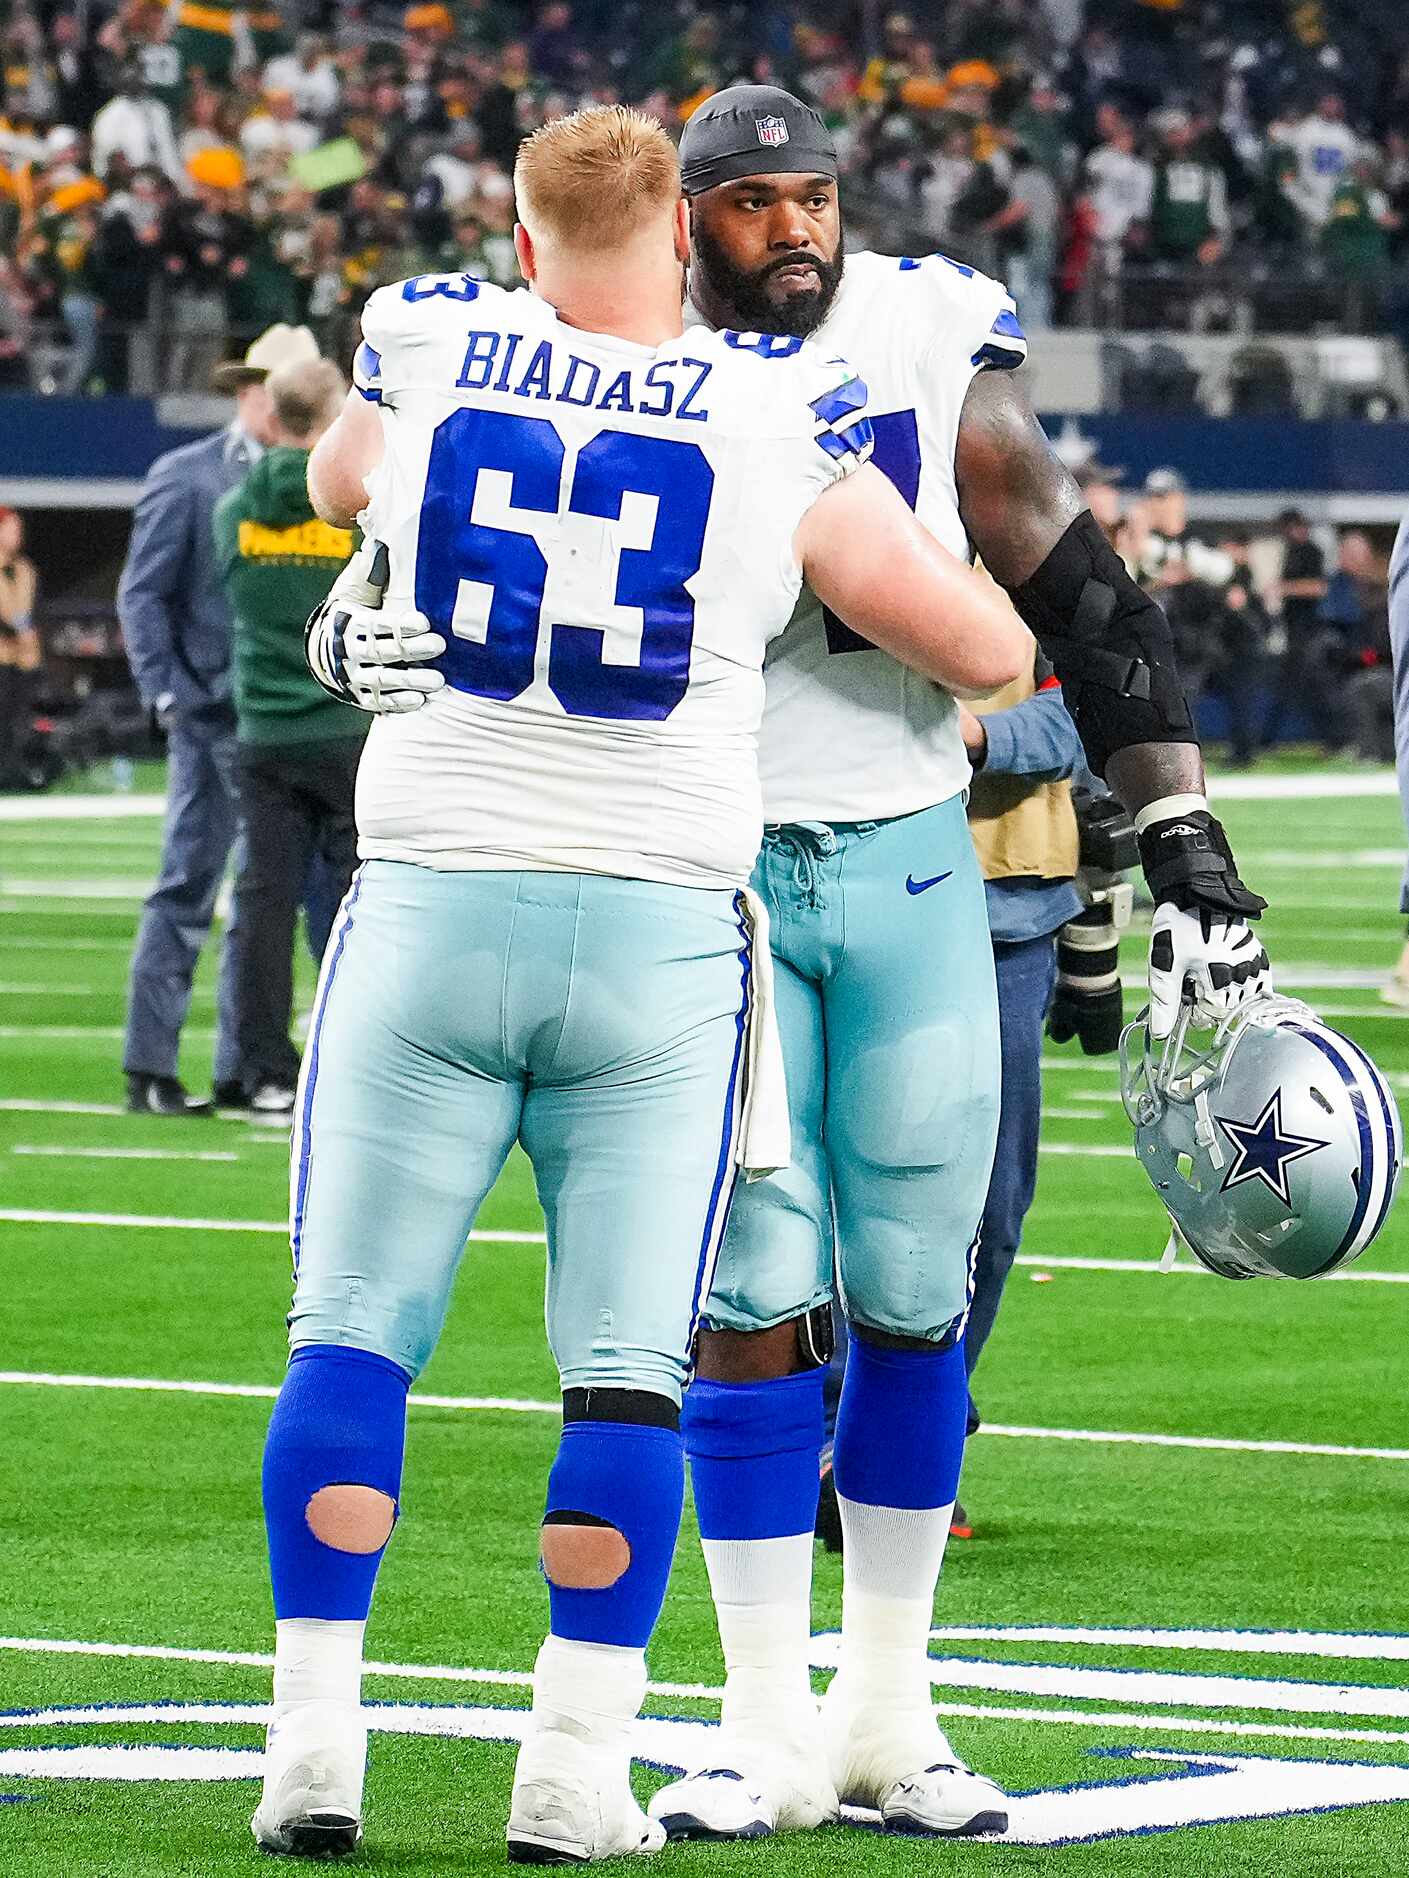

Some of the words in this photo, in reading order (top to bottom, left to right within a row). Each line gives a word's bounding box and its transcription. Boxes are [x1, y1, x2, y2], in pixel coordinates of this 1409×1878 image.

[760, 127, 785, 142] NFL
[455, 330, 713, 422] BIADASZ
[414, 406, 715, 721] 63
